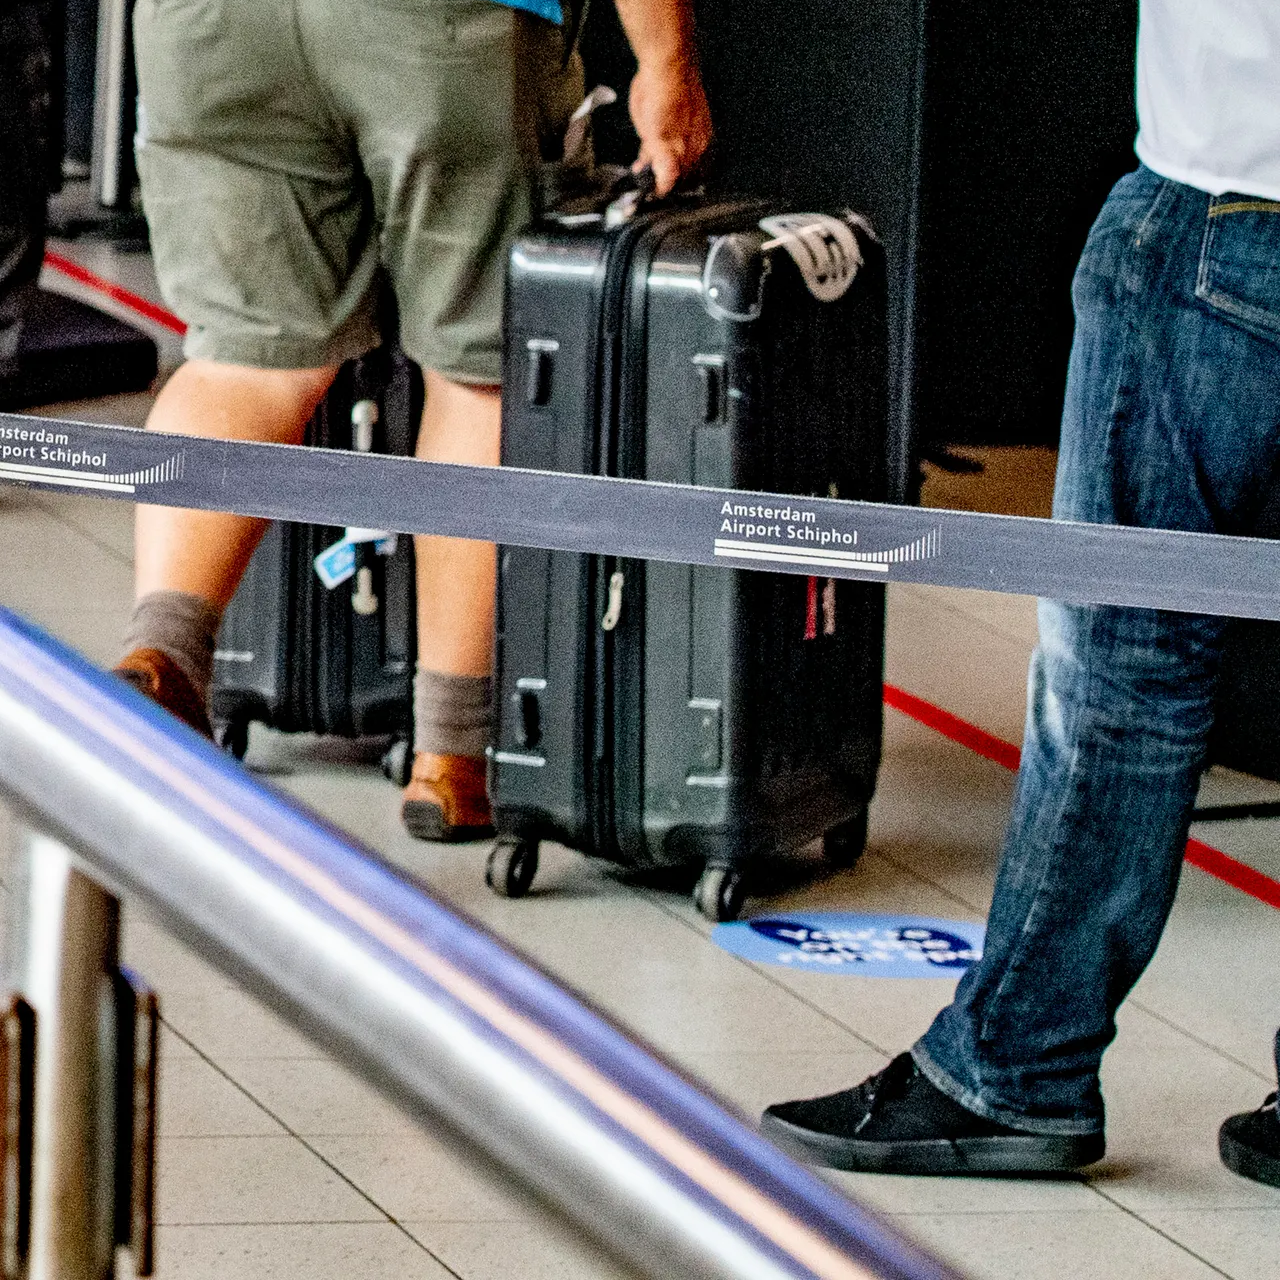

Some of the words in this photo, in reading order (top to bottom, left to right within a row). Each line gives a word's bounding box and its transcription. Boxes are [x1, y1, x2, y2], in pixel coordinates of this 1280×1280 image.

[41, 448, 107, 466] Schiphol
[721, 502, 816, 522] Amsterdam
[721, 520, 781, 537] Airport
[787, 526, 857, 545] Schiphol
